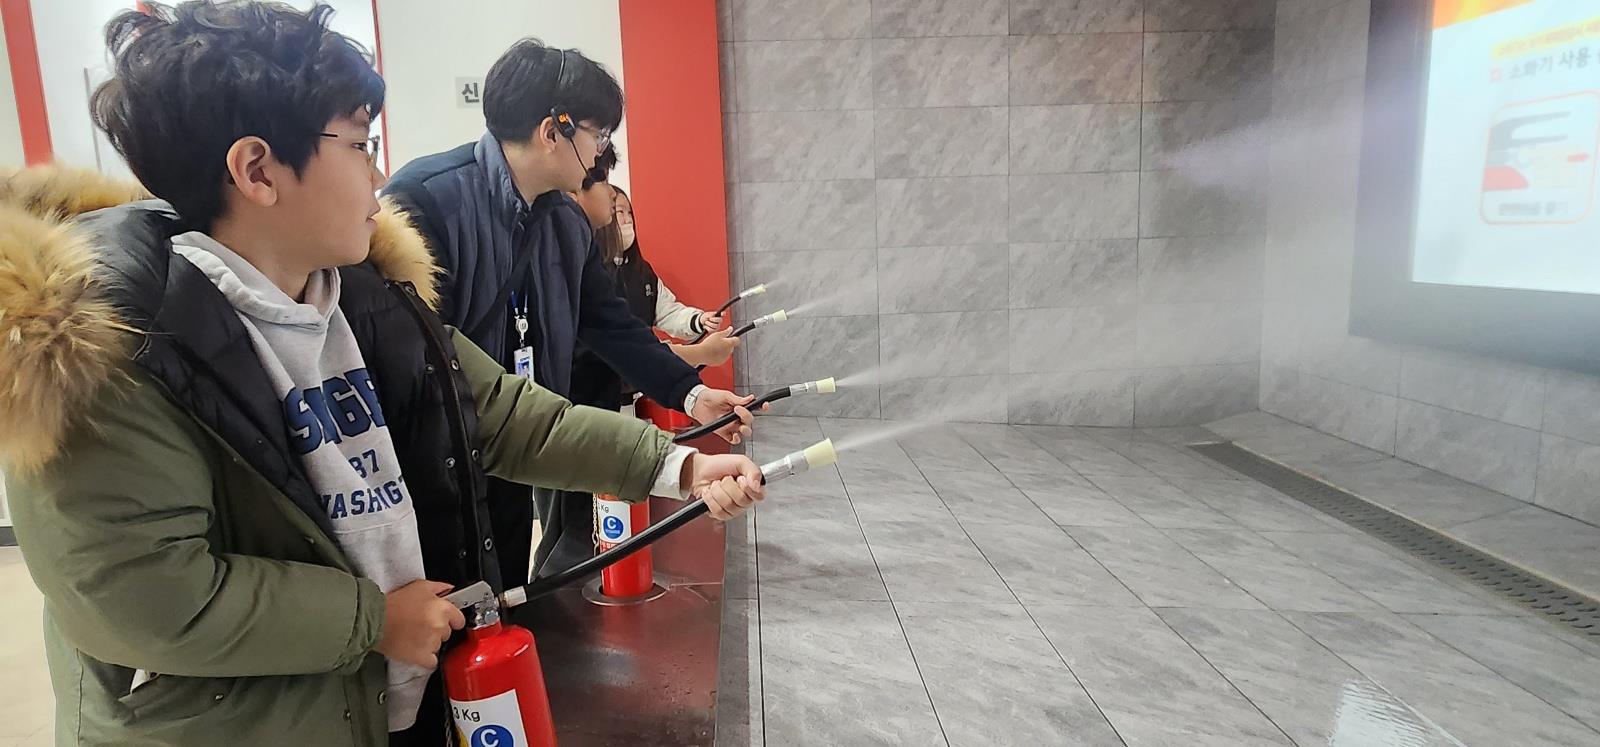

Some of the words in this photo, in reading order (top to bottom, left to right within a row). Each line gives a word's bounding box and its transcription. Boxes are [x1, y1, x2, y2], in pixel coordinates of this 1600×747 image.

[1558, 46, 1592, 71] 사용
[461, 82, 480, 103] 신
[606, 517, 617, 530] C
[462, 708, 480, 722] Kg
[480, 728, 500, 747] C
